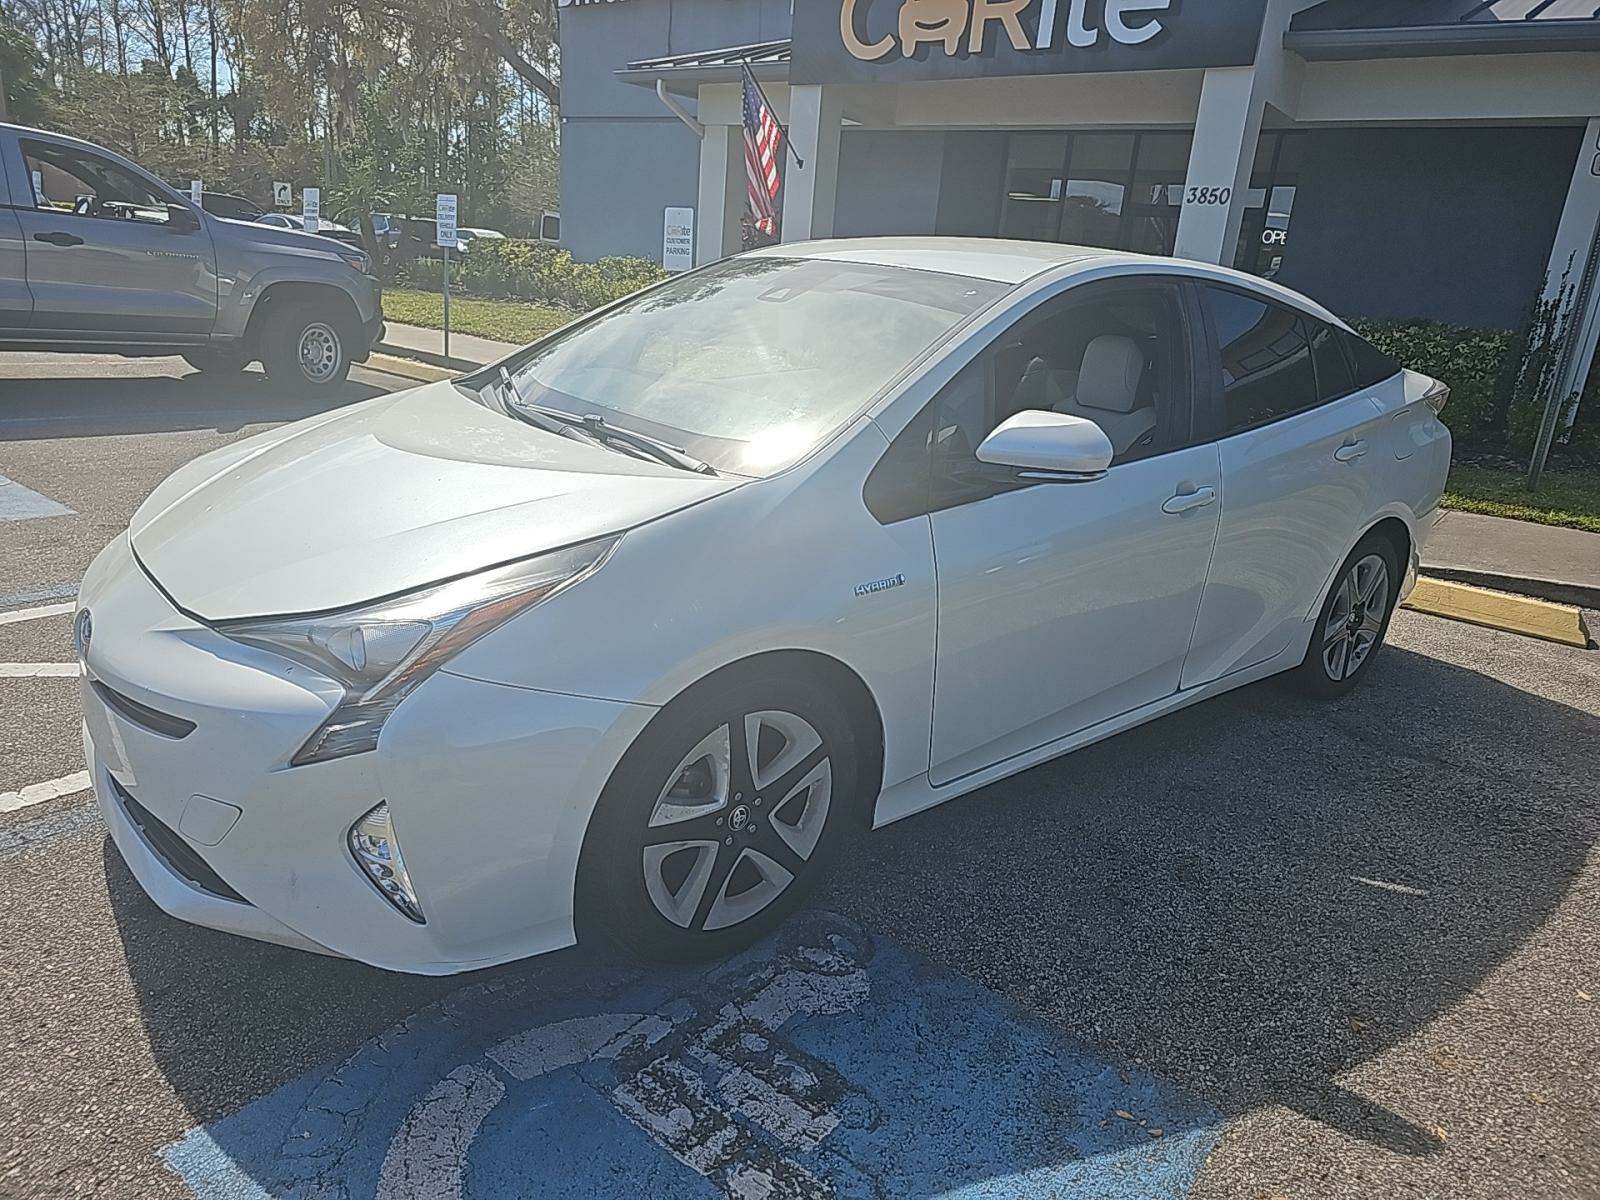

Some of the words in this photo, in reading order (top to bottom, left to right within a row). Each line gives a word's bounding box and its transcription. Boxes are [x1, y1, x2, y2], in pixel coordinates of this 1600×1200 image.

[1186, 186, 1231, 205] 3850
[665, 237, 691, 245] CUSTOMER
[665, 247, 690, 256] PARKING
